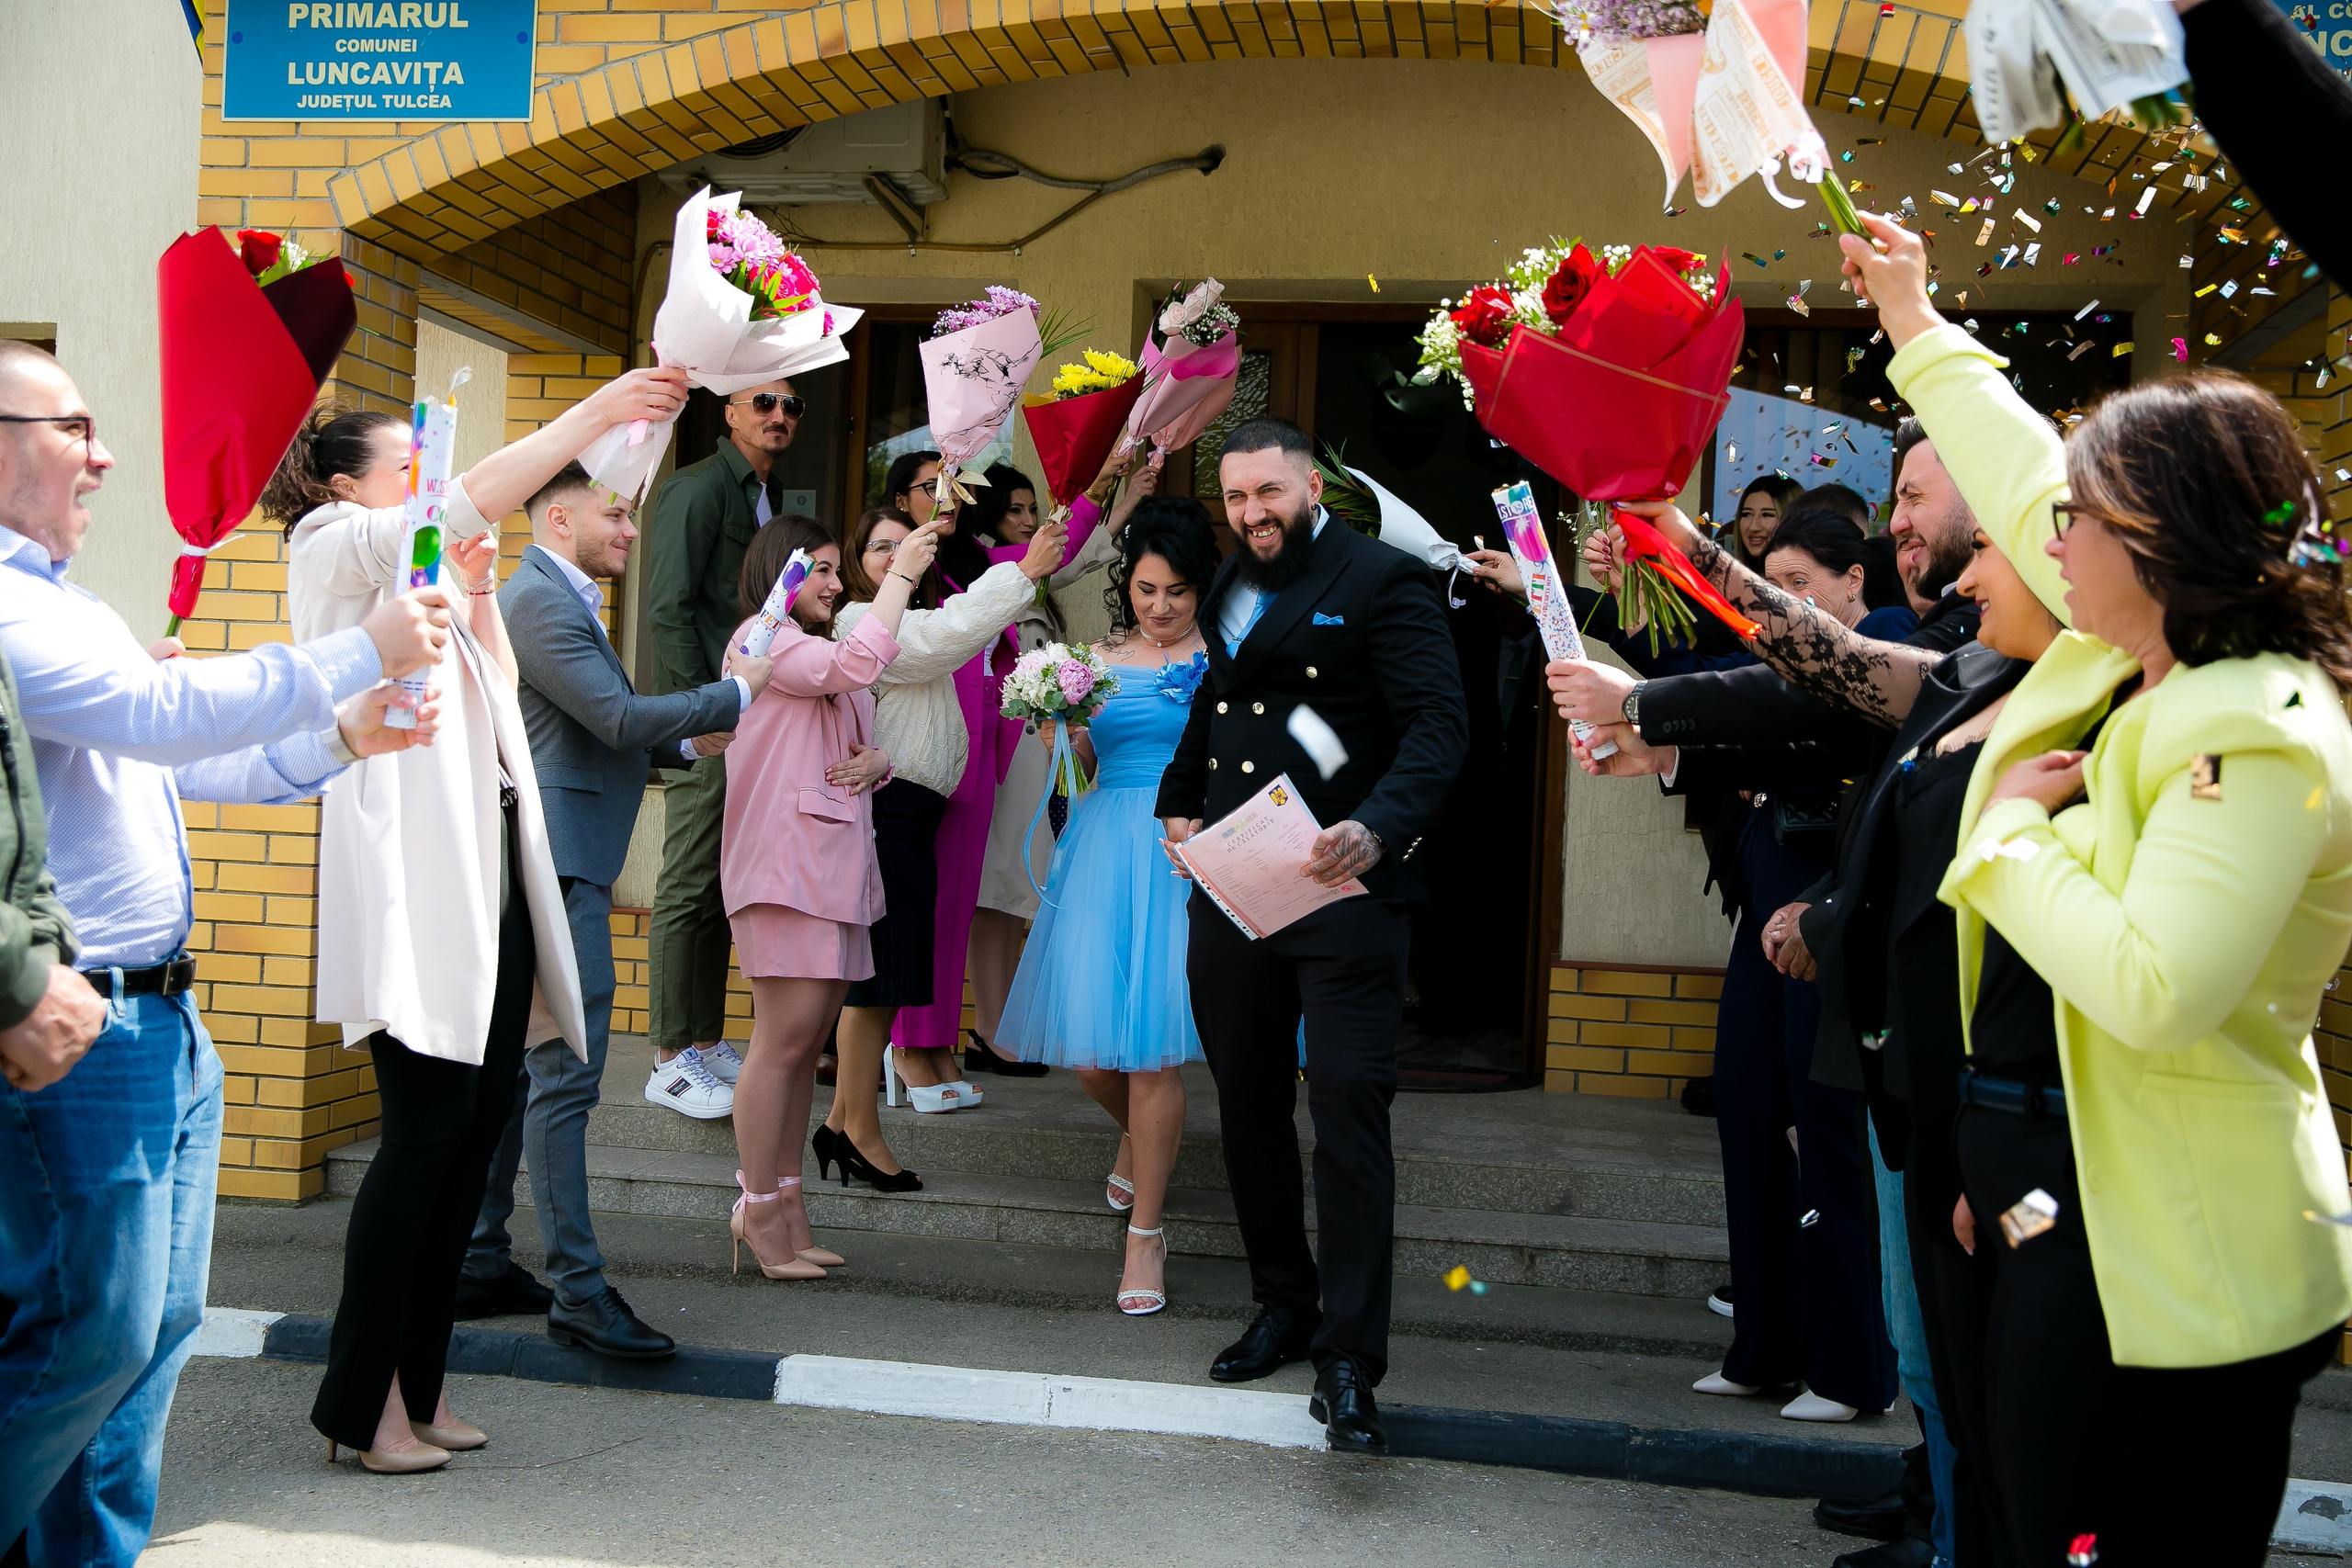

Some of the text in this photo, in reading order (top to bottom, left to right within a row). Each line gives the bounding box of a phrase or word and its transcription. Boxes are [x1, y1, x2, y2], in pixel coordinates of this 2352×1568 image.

[288, 2, 469, 28] PRIMARUL
[334, 39, 418, 52] COMUNEI
[381, 95, 452, 108] TULCEA
